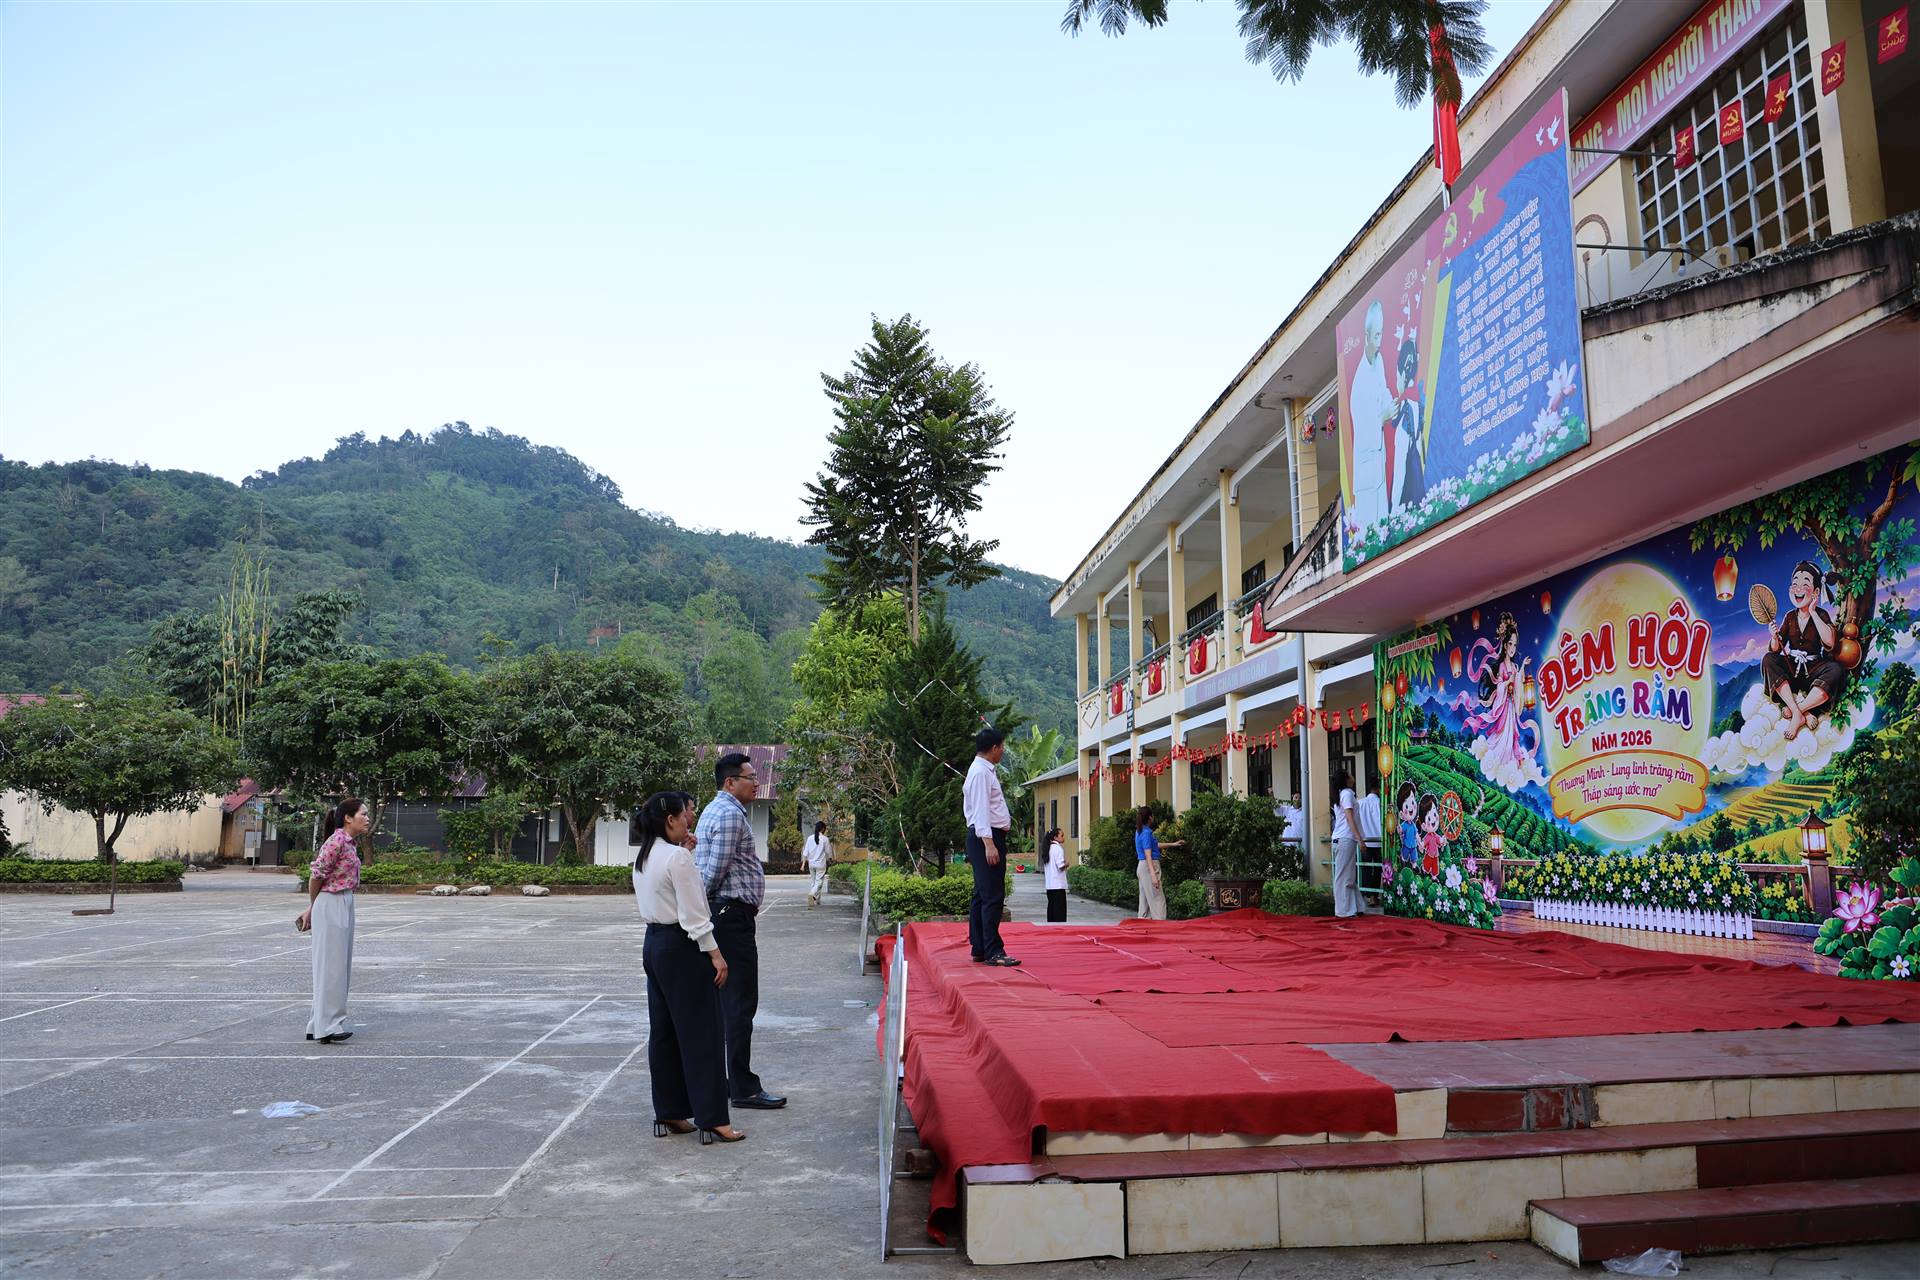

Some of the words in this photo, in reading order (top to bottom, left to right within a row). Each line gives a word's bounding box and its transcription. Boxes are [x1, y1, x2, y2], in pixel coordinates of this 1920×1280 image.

[1616, 79, 1647, 138] MỌI
[1651, 25, 1705, 108] NGƯỜI
[1539, 621, 1616, 709] ĐÊM
[1628, 598, 1711, 681] HỘI
[1555, 687, 1626, 747] TRĂNG
[1632, 673, 1692, 730] RẰM
[1592, 732, 1617, 752] NĂM
[1621, 730, 1652, 747] 2026
[1582, 785, 1601, 804] Thắp
[1604, 784, 1623, 800] sáng
[1625, 781, 1640, 796] ước
[1587, 765, 1605, 781] Minh
[1611, 763, 1630, 780] Lung
[1633, 761, 1648, 775] linh
[1650, 764, 1673, 783] trăng
[1675, 763, 1695, 784] rằm
